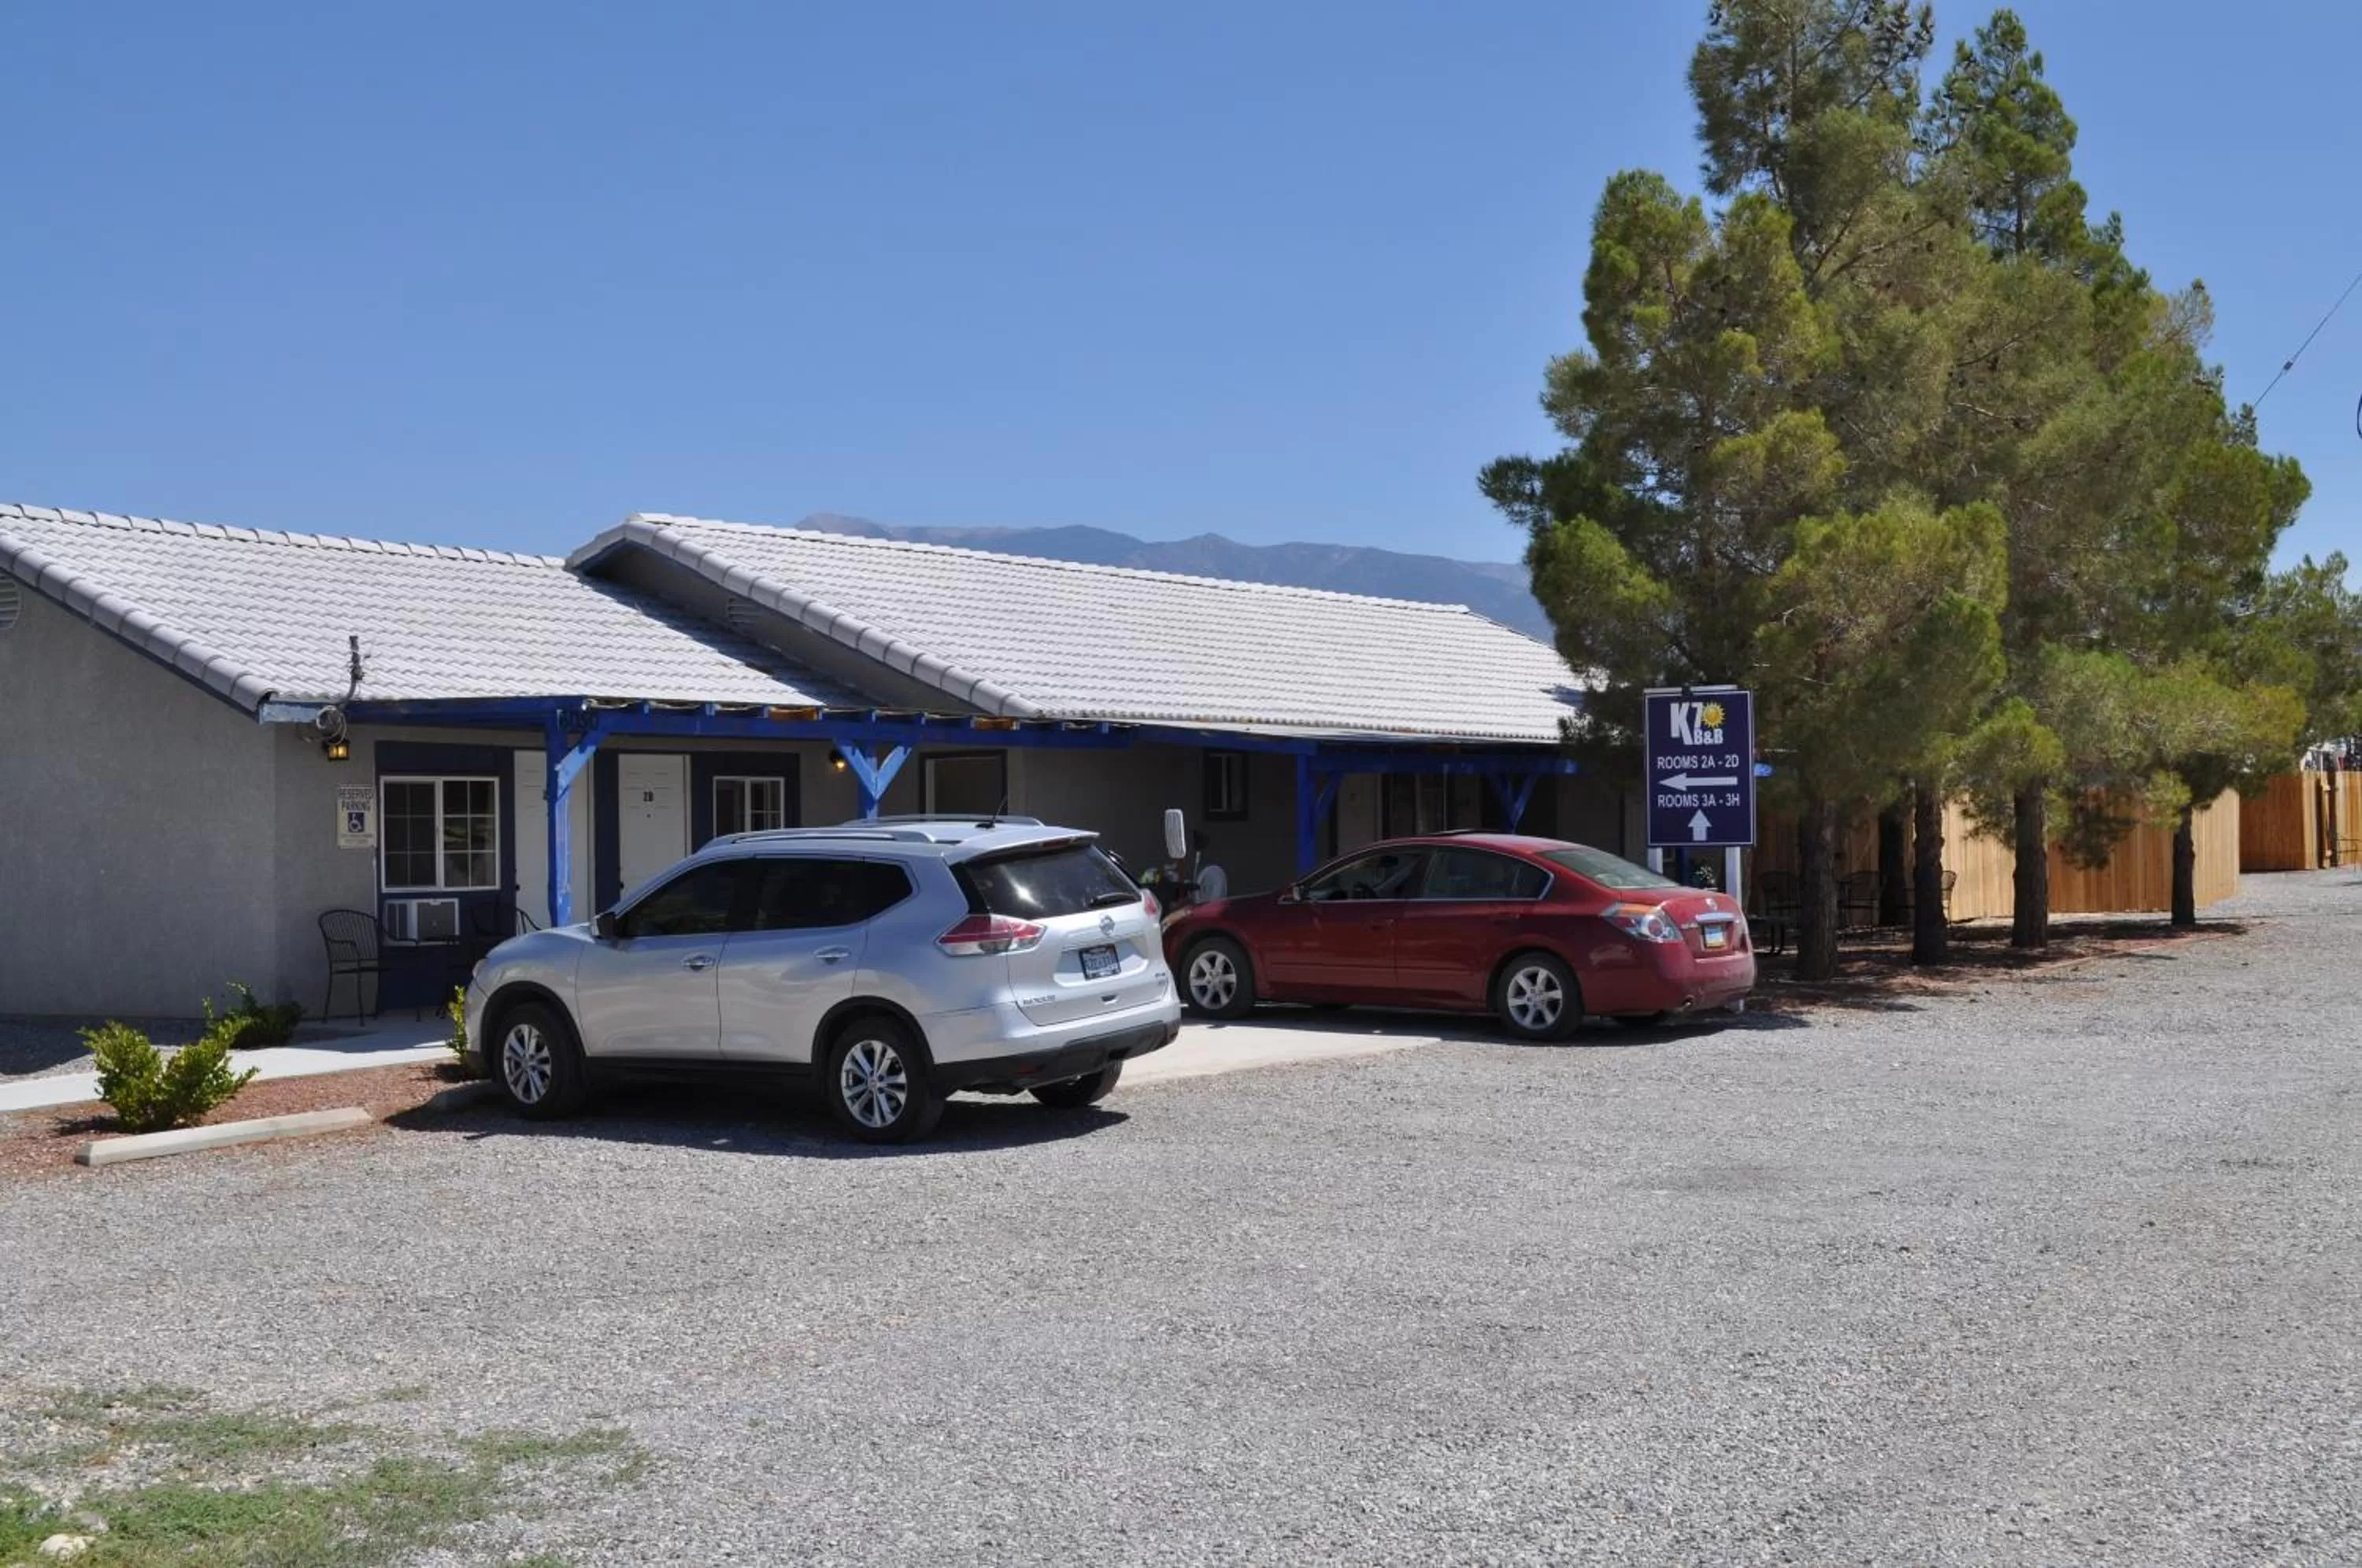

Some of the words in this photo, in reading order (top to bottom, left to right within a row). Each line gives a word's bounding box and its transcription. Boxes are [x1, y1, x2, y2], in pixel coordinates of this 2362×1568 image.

[1694, 728, 1724, 745] B&B
[1657, 756, 1698, 769] ROOMS
[1701, 756, 1716, 768] 2A
[1725, 755, 1739, 768] 2D
[1657, 794, 1699, 807] ROOMS
[1702, 794, 1716, 807] 3A
[1725, 793, 1740, 807] 3H
